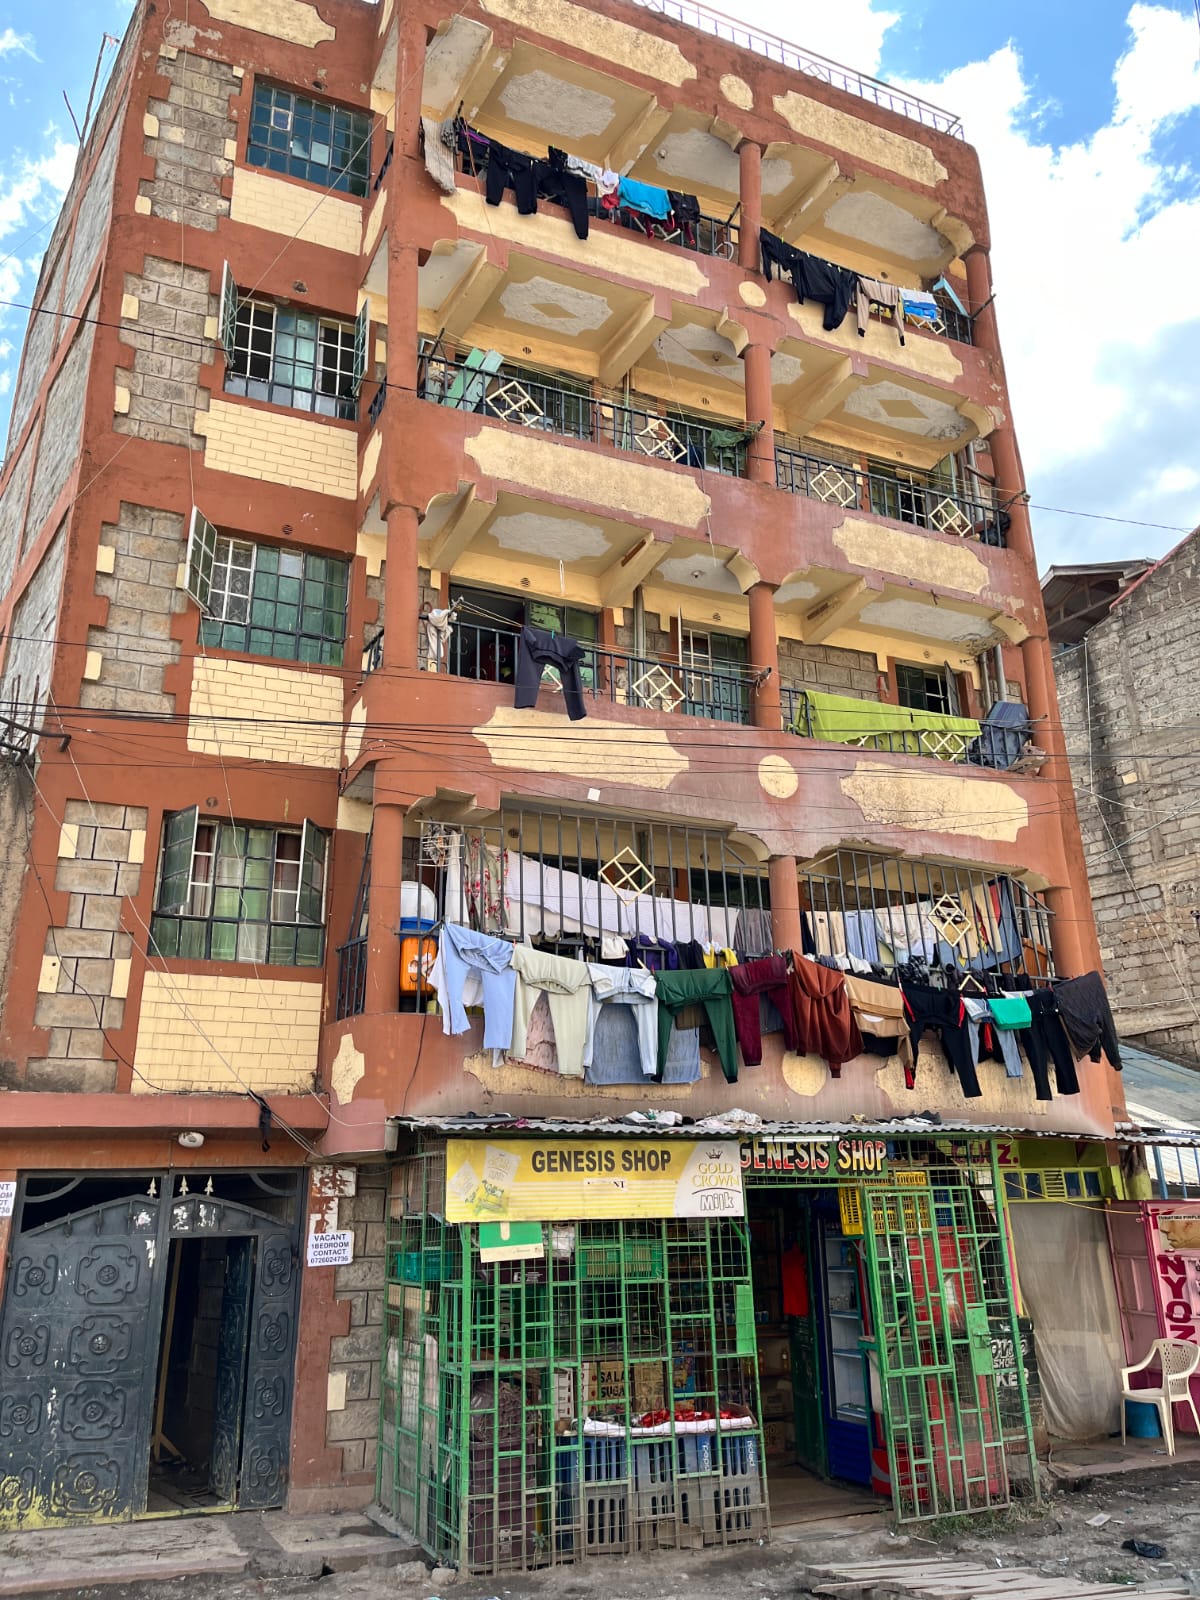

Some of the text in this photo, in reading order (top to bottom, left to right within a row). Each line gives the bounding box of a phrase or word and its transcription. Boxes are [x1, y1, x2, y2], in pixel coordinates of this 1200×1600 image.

[739, 1137, 886, 1171] GENESIS SHOP
[532, 1150, 615, 1172] GENESIS
[621, 1150, 672, 1171] SHOP
[698, 1162, 734, 1174] GOLD
[691, 1174, 740, 1187] CROWN
[700, 1191, 734, 1210] Milk
[314, 1233, 347, 1241] VACANT
[313, 1249, 346, 1257] CONTACT
